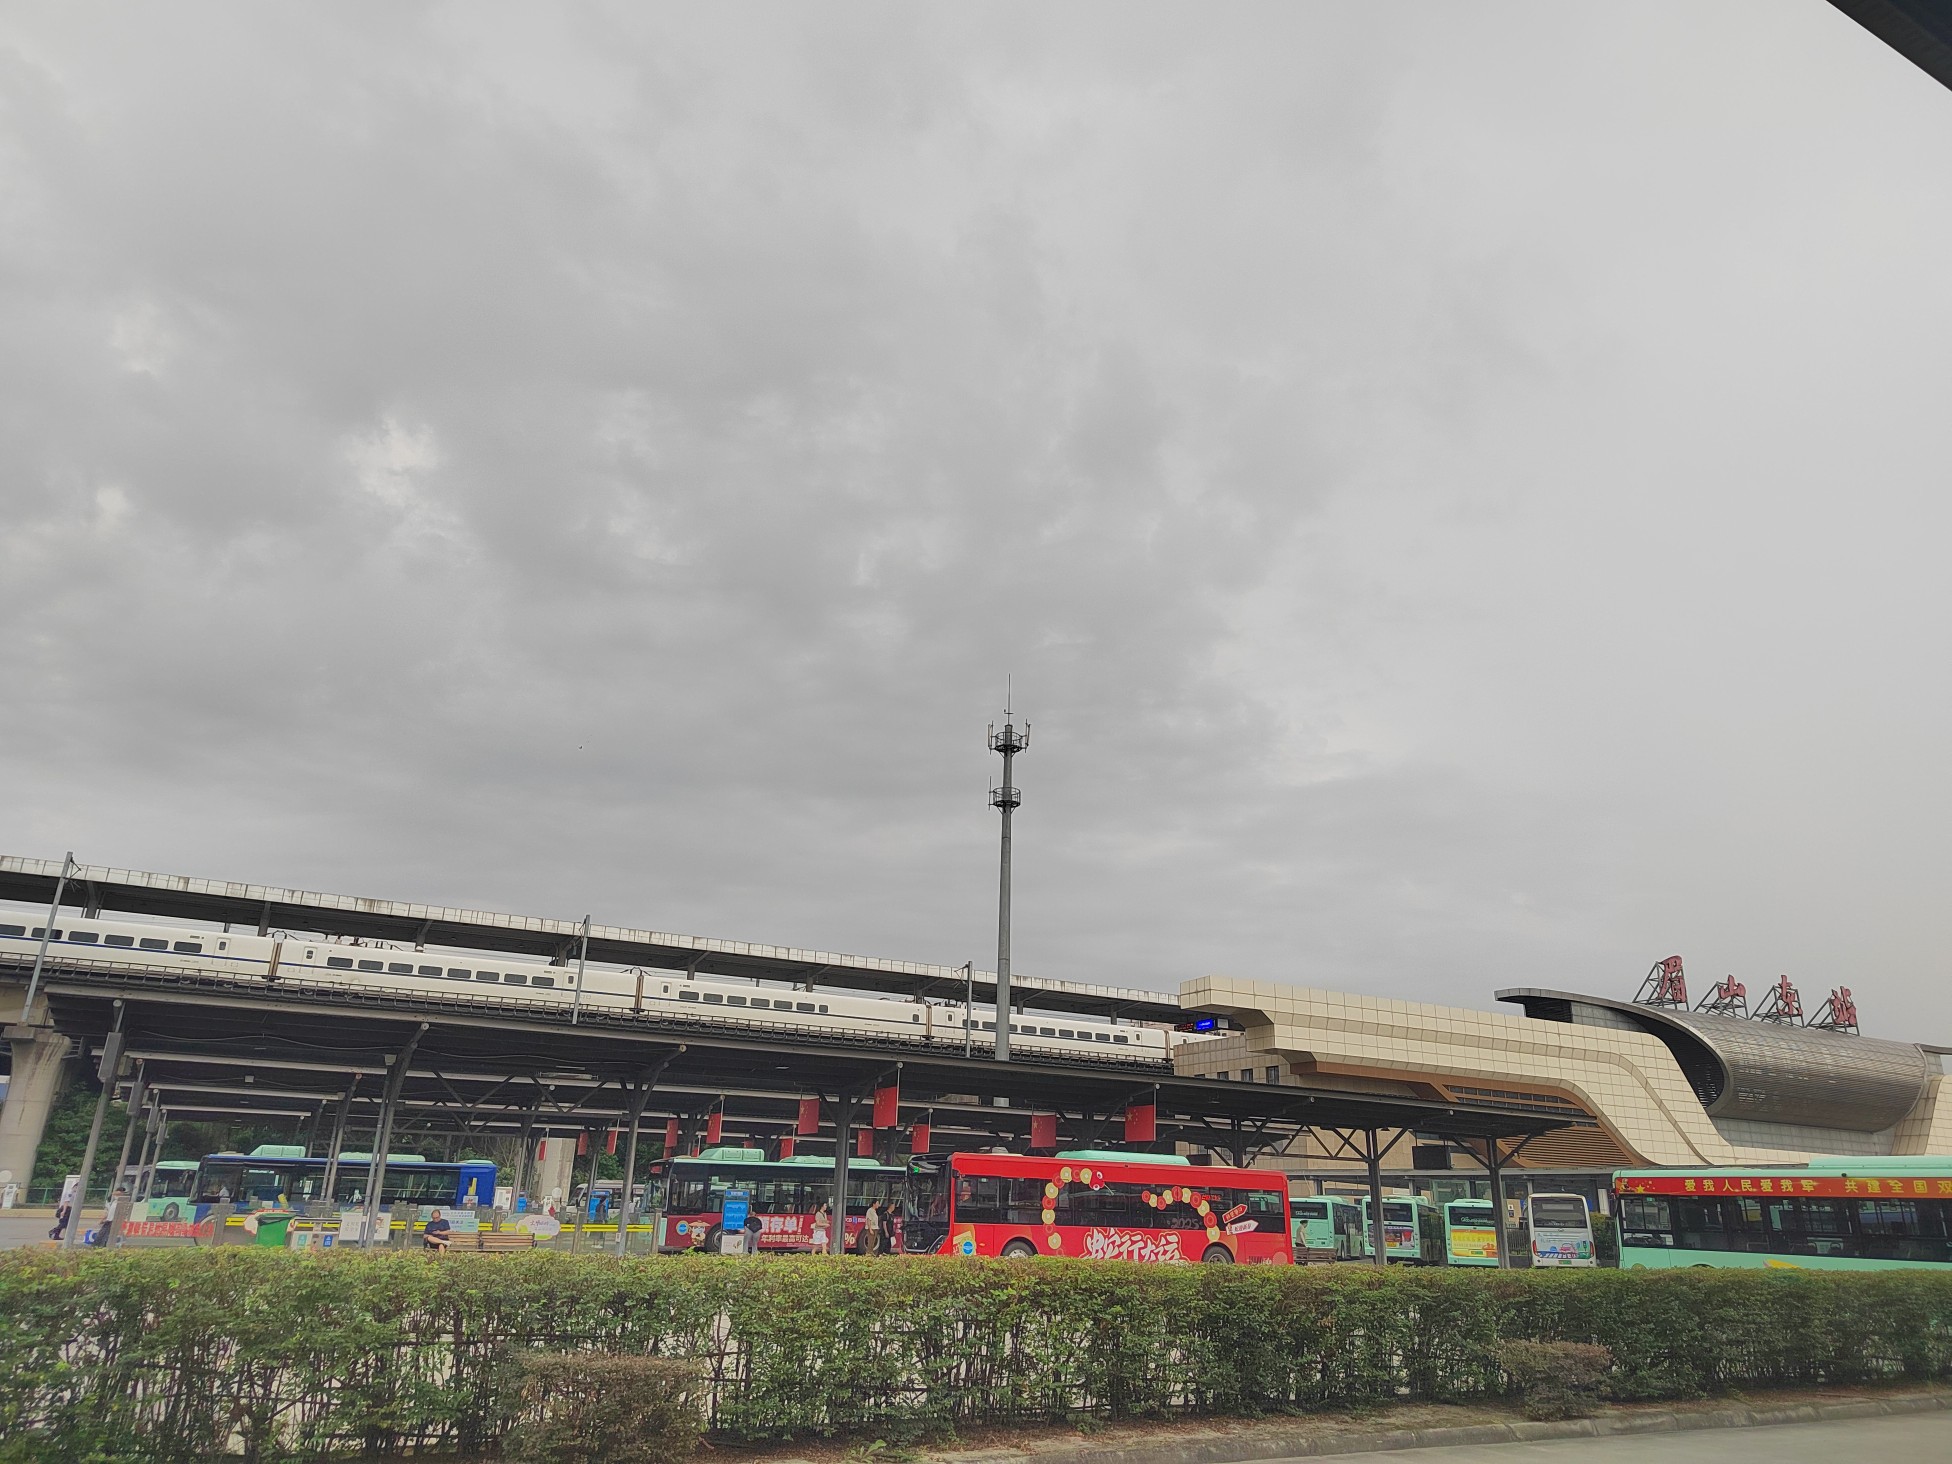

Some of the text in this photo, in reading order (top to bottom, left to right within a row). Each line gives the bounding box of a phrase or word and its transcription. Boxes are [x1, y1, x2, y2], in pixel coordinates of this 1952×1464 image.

[1657, 955, 1857, 1026] 眉山东站
[1171, 1218, 1199, 1229] 2025
[761, 1234, 809, 1243] 年利率最高可达
[1086, 1228, 1181, 1262] 蛇行大运
